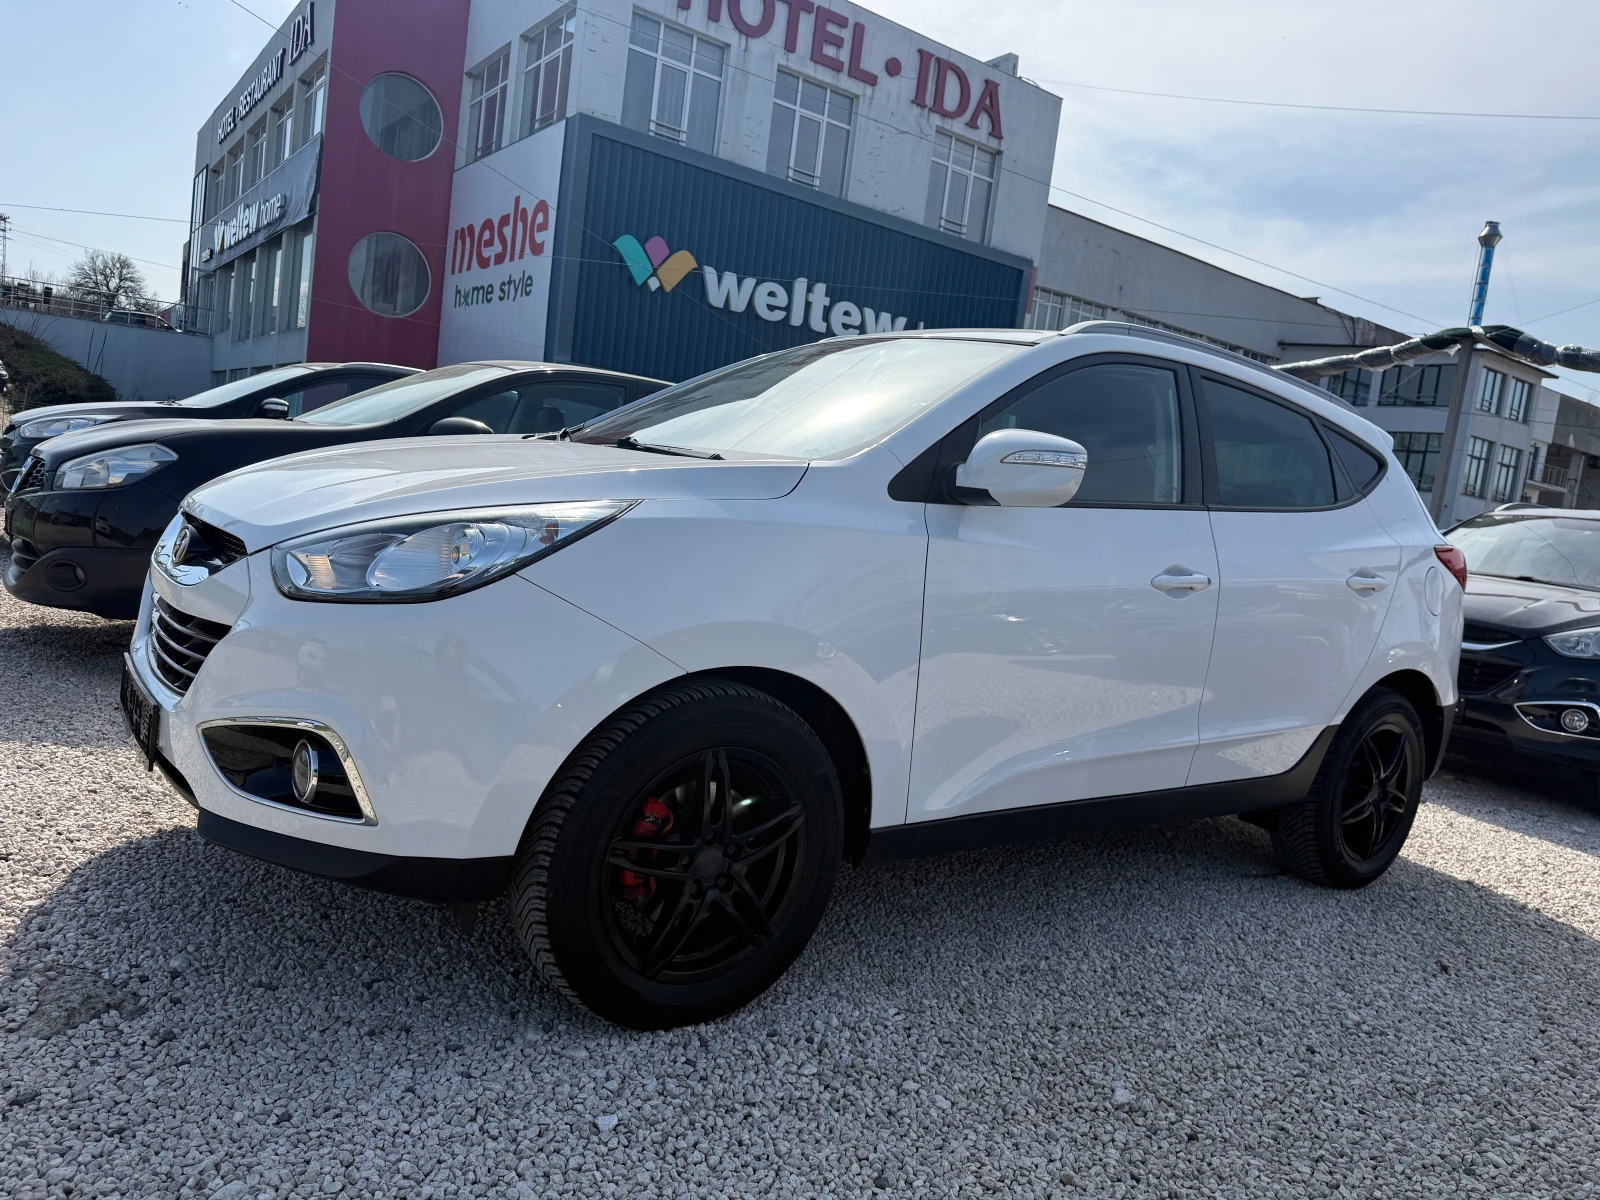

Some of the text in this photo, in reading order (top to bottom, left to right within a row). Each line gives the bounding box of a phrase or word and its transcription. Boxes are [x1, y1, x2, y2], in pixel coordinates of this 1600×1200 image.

[218, 1, 315, 143] HOTEL RESTAURANT IDA
[910, 48, 1004, 139] IDA
[224, 192, 283, 249] weltew home
[450, 195, 549, 276] meshe
[498, 270, 534, 302] style
